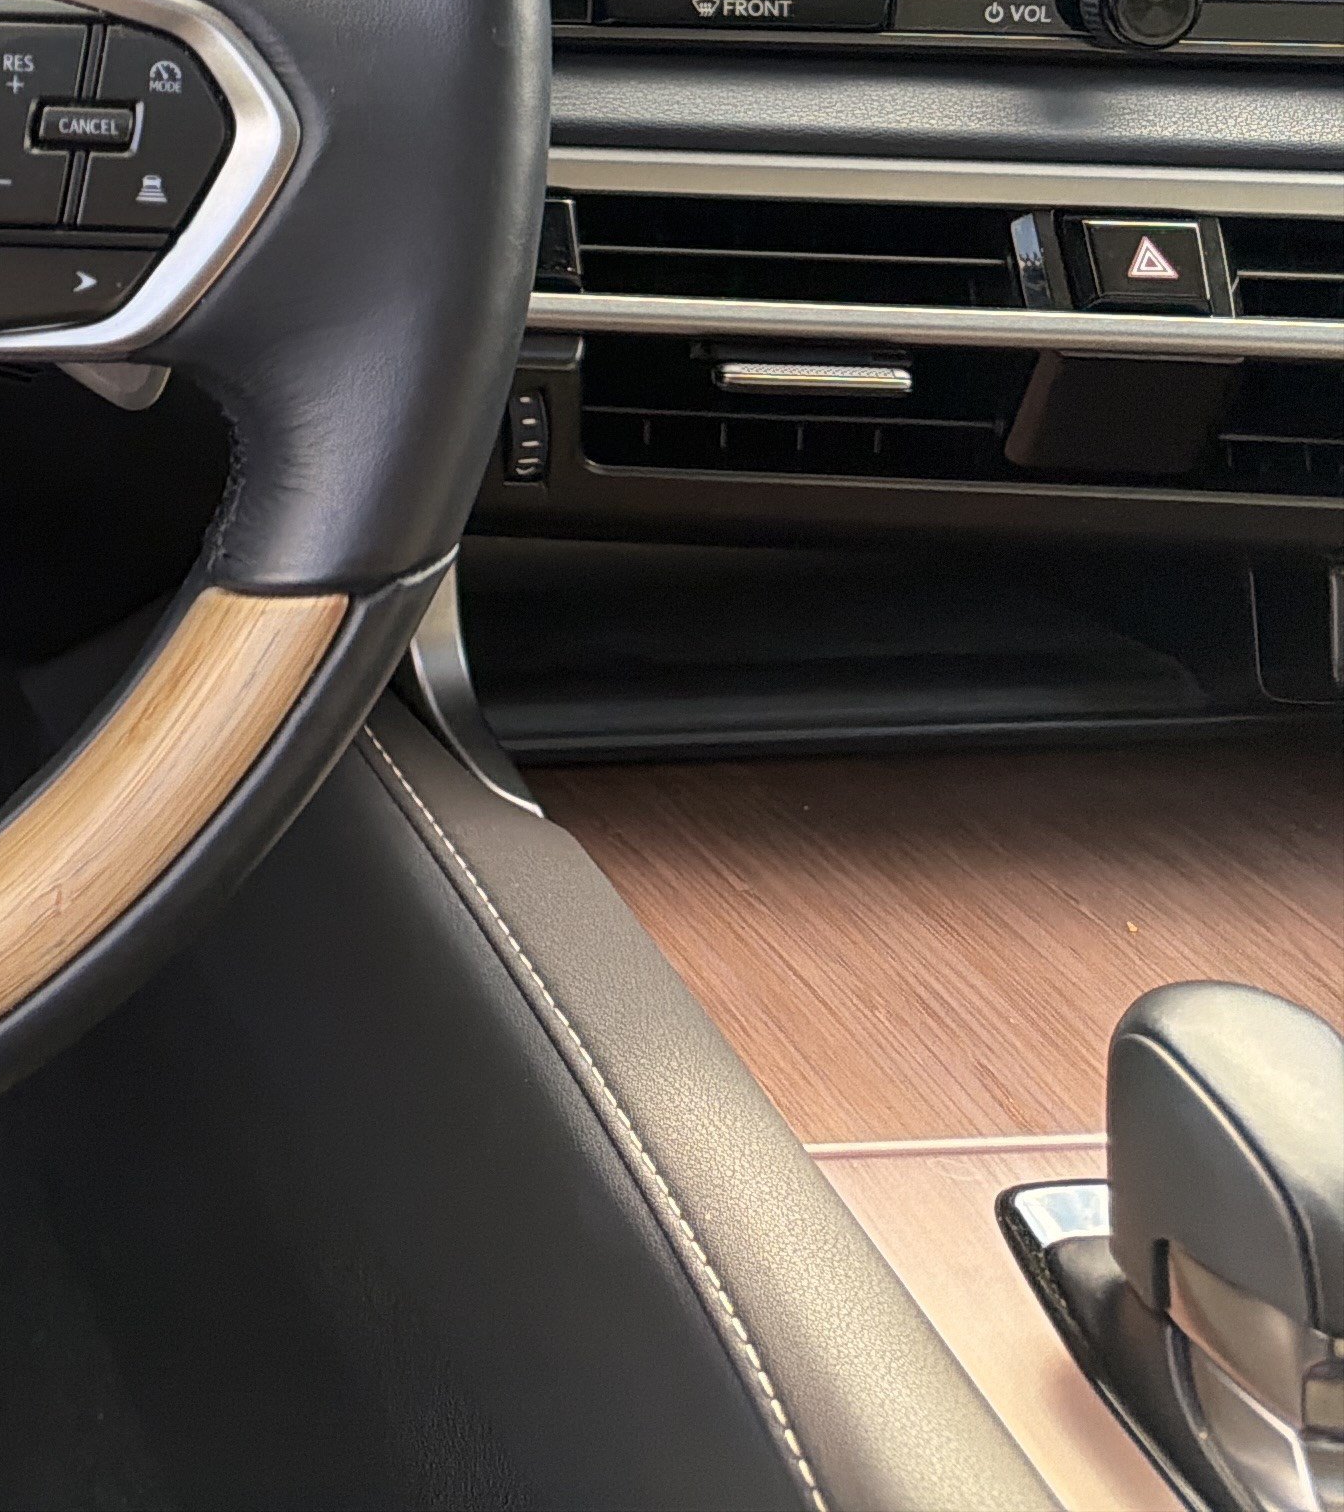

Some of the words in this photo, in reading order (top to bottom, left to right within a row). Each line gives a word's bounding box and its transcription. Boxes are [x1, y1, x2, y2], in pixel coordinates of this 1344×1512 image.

[722, 0, 793, 17] FRONT
[1010, 4, 1052, 23] VOL
[3, 55, 35, 73] RES
[149, 81, 182, 93] MODE
[59, 118, 119, 136] CANCEL
